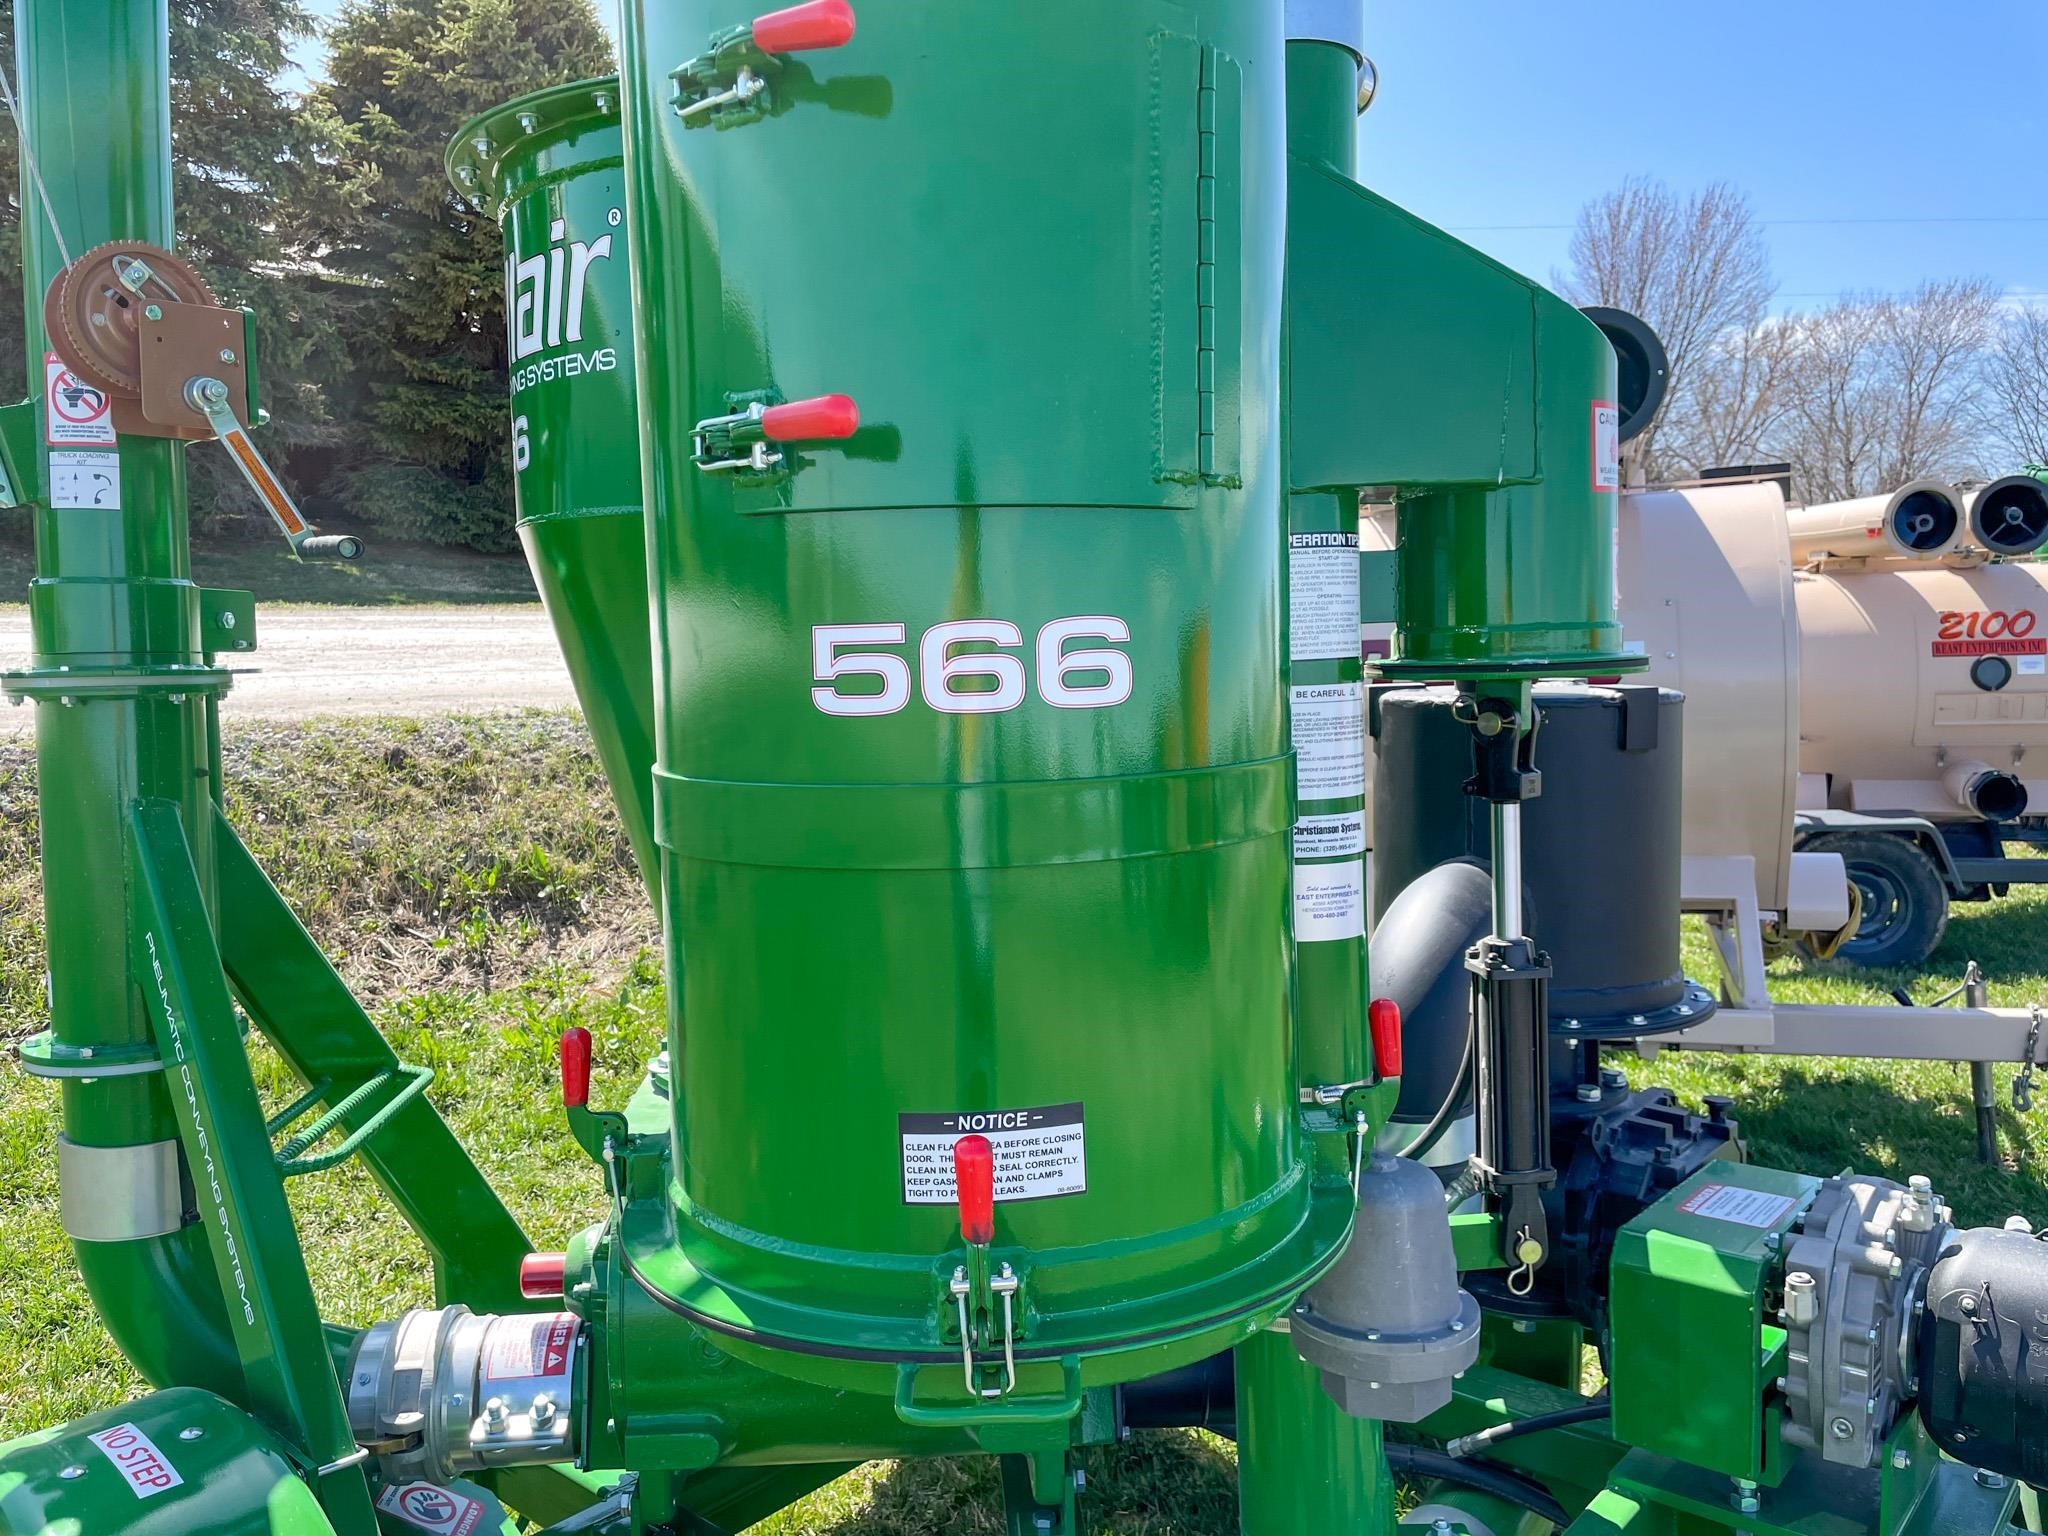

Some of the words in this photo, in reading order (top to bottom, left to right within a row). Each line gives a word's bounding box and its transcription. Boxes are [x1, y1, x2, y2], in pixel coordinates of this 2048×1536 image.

[526, 349, 617, 387] SYSTEMS
[1938, 610, 2036, 639] 2100
[1966, 640, 2027, 654] ENTERPRISES
[811, 615, 1134, 716] 566
[1310, 689, 1346, 698] CAREFUL
[1315, 891, 1353, 899] ENTERPRISES
[146, 931, 184, 1062] PNEUMATIC
[181, 1065, 222, 1203] CONVEYING
[219, 1206, 254, 1326] SYSTEMS
[958, 1112, 1028, 1131] NOTICE
[905, 1143, 936, 1151] CLEAN
[938, 1143, 954, 1151] FLA
[1004, 1138, 1041, 1148] BEFORE
[1043, 1132, 1082, 1144] CLOSING
[906, 1155, 934, 1163] DOOR.
[1002, 1151, 1026, 1160] MUST
[1029, 1147, 1063, 1158] REMAIN
[939, 1166, 948, 1174] IN
[999, 1164, 1022, 1172] SEAL
[1025, 1156, 1079, 1169] CORRECTLY.
[907, 1178, 930, 1186] KEEP
[932, 1178, 958, 1186] GASK
[1005, 1174, 1024, 1183] AND
[1027, 1170, 1063, 1181] CLAMPS
[908, 1189, 934, 1197] TIGHT
[936, 1189, 948, 1197] TO
[995, 1186, 1027, 1195] LEAKS.
[551, 1322, 569, 1346] GER
[96, 1426, 137, 1449] NO
[117, 1447, 172, 1487] STEP
[456, 1509, 478, 1536] DANGE
